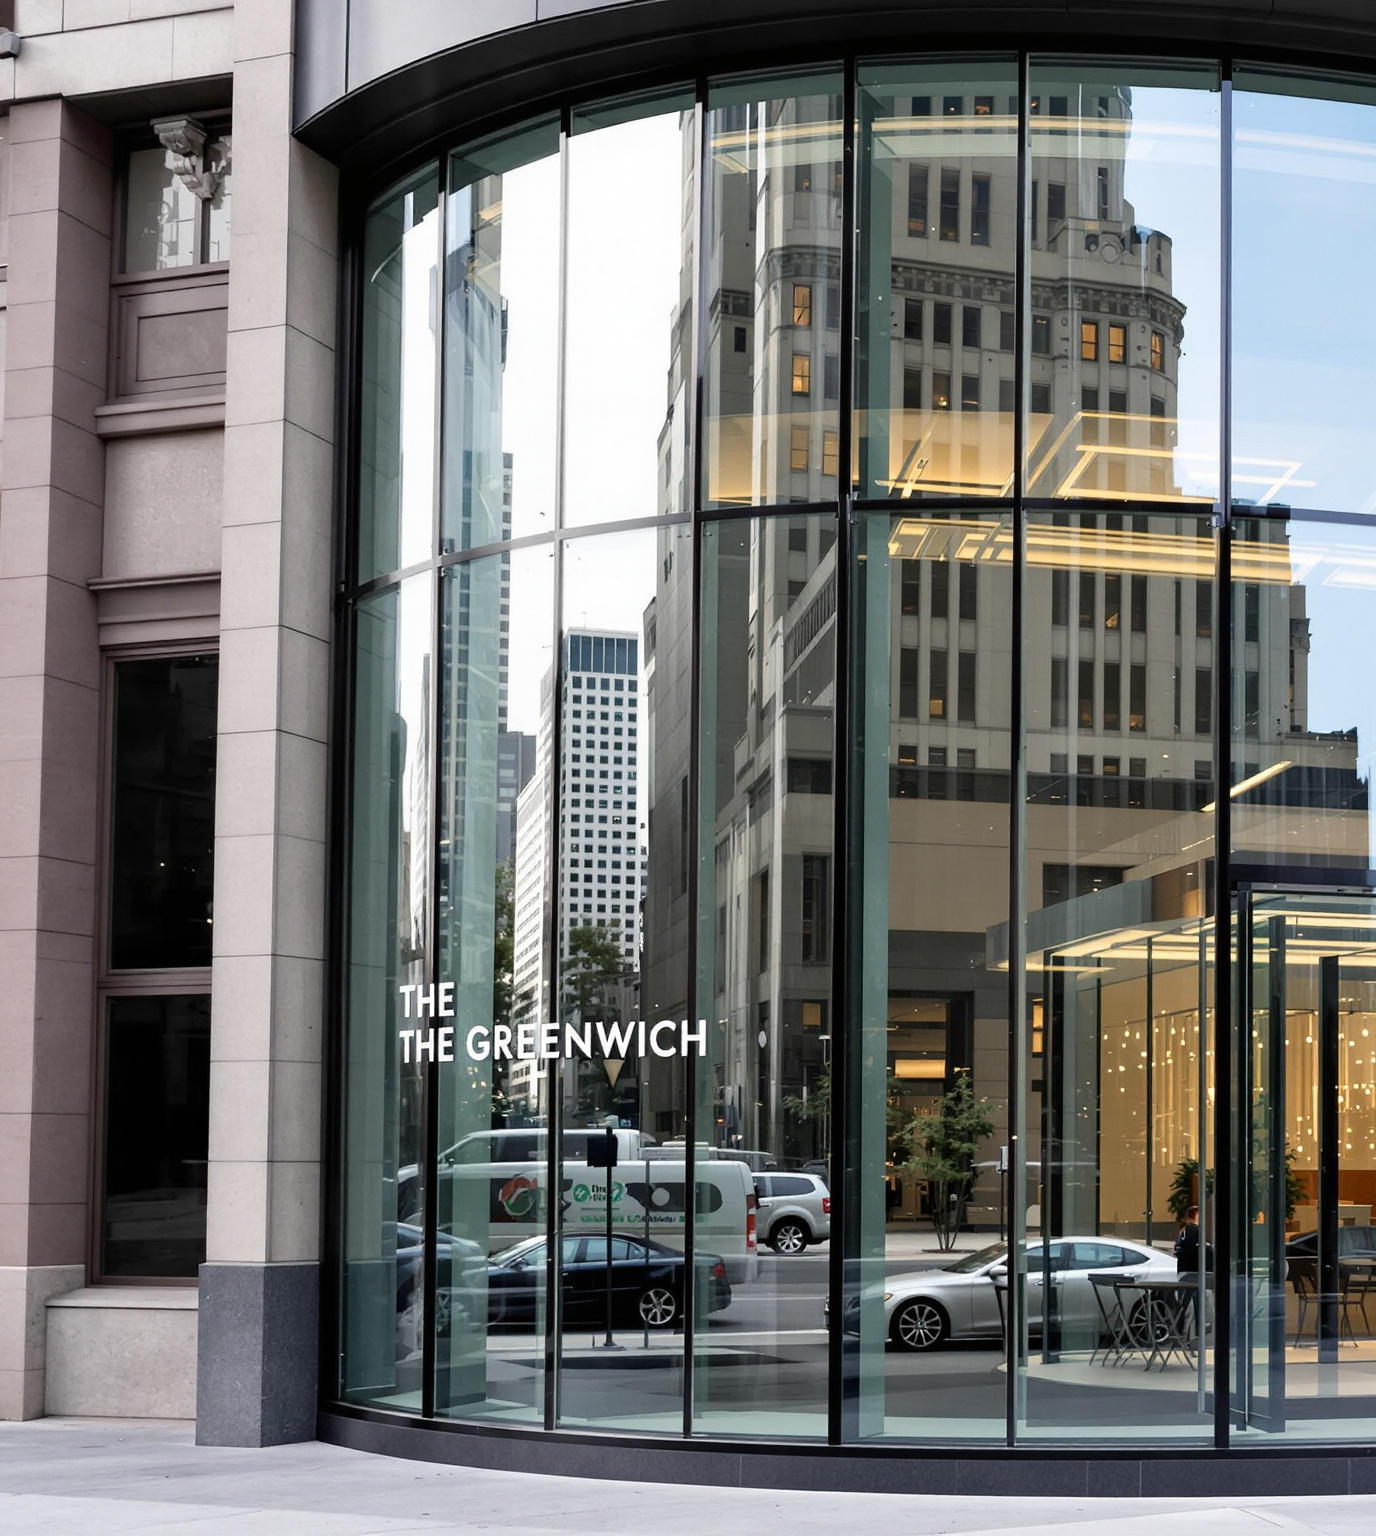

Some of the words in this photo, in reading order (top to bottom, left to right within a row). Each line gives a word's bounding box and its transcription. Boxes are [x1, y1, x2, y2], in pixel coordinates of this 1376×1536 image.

[399, 981, 455, 1018] THE
[399, 1026, 454, 1064] THE
[466, 1019, 707, 1062] GREENWICH
